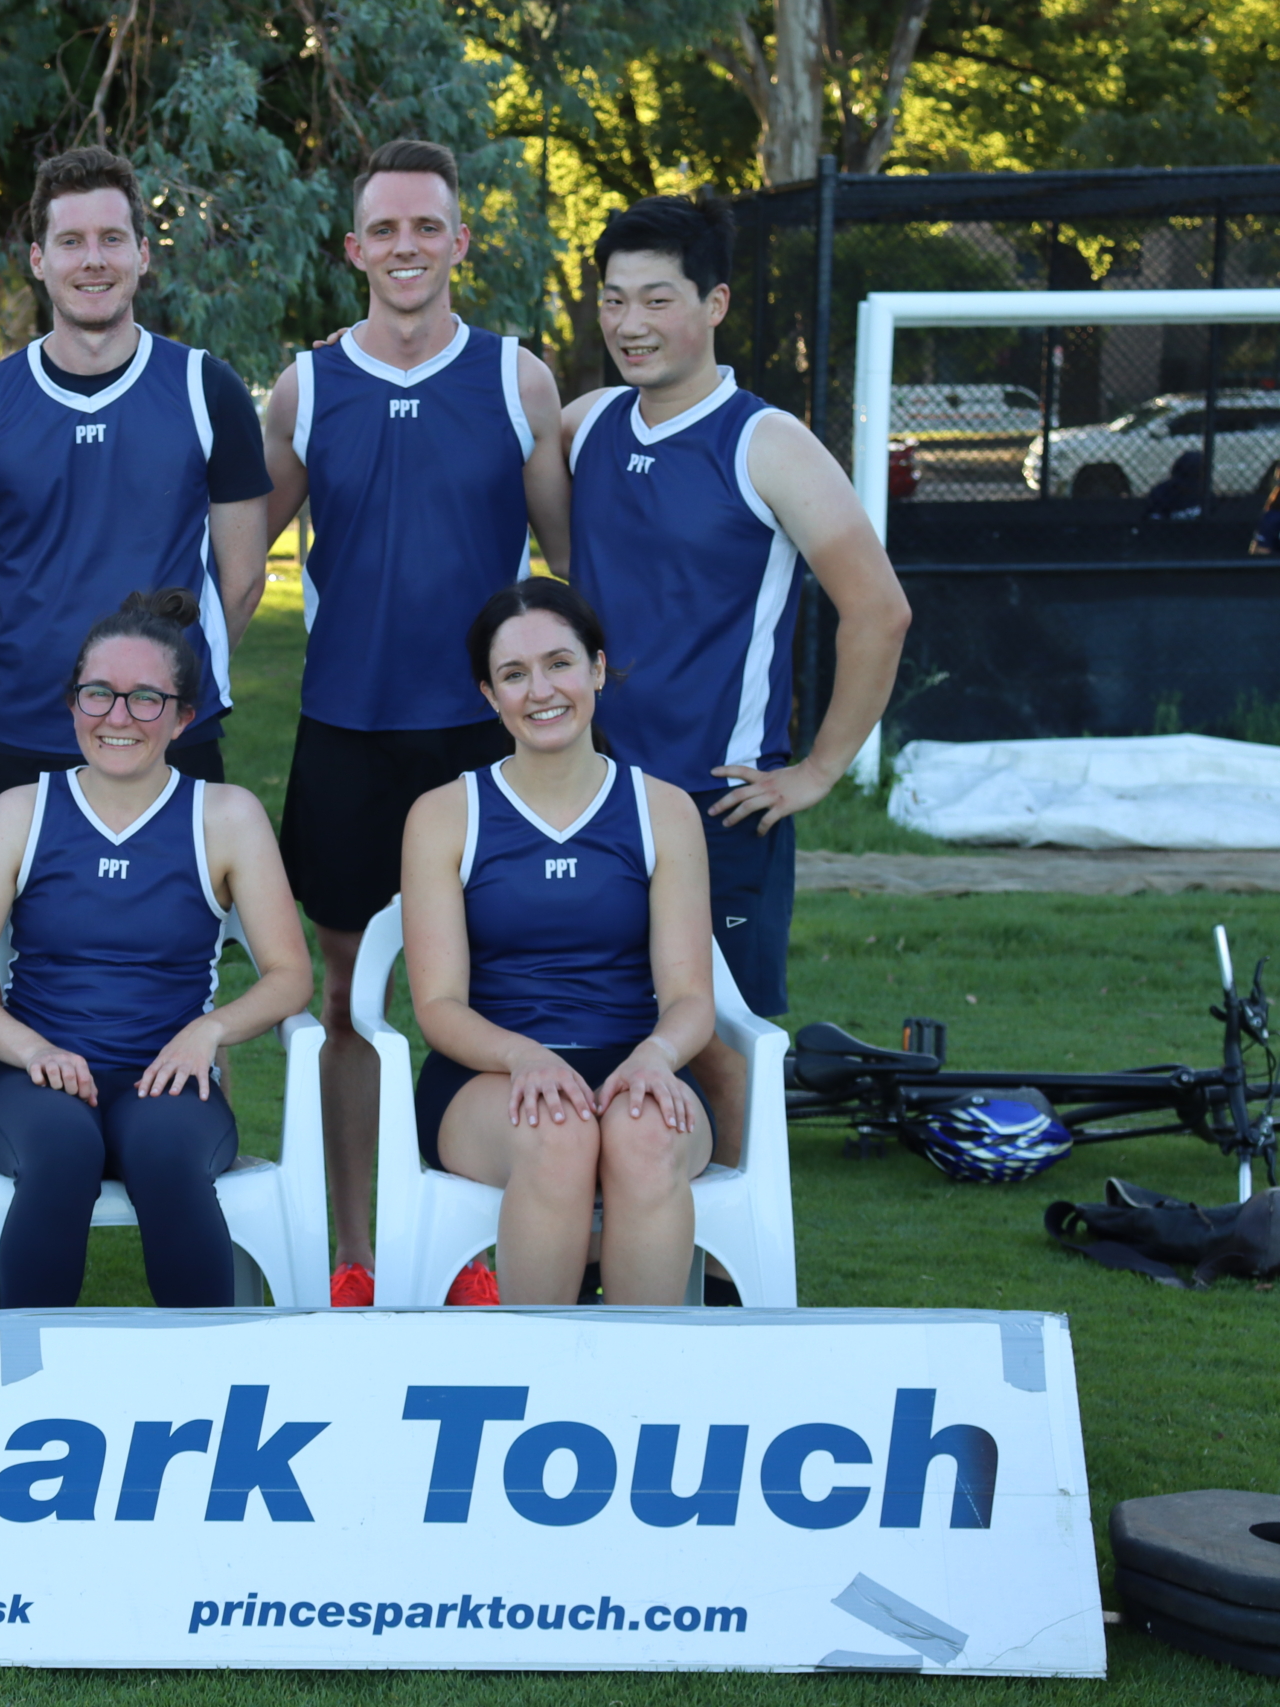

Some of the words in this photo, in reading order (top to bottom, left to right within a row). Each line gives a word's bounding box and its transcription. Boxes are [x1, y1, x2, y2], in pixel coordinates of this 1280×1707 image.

[389, 398, 421, 419] PPT
[75, 423, 107, 445] PPT
[97, 857, 130, 880] PPT
[544, 857, 578, 880] PPT
[402, 1386, 999, 1530] Touch
[189, 1592, 748, 1636] princesparktouch.com
